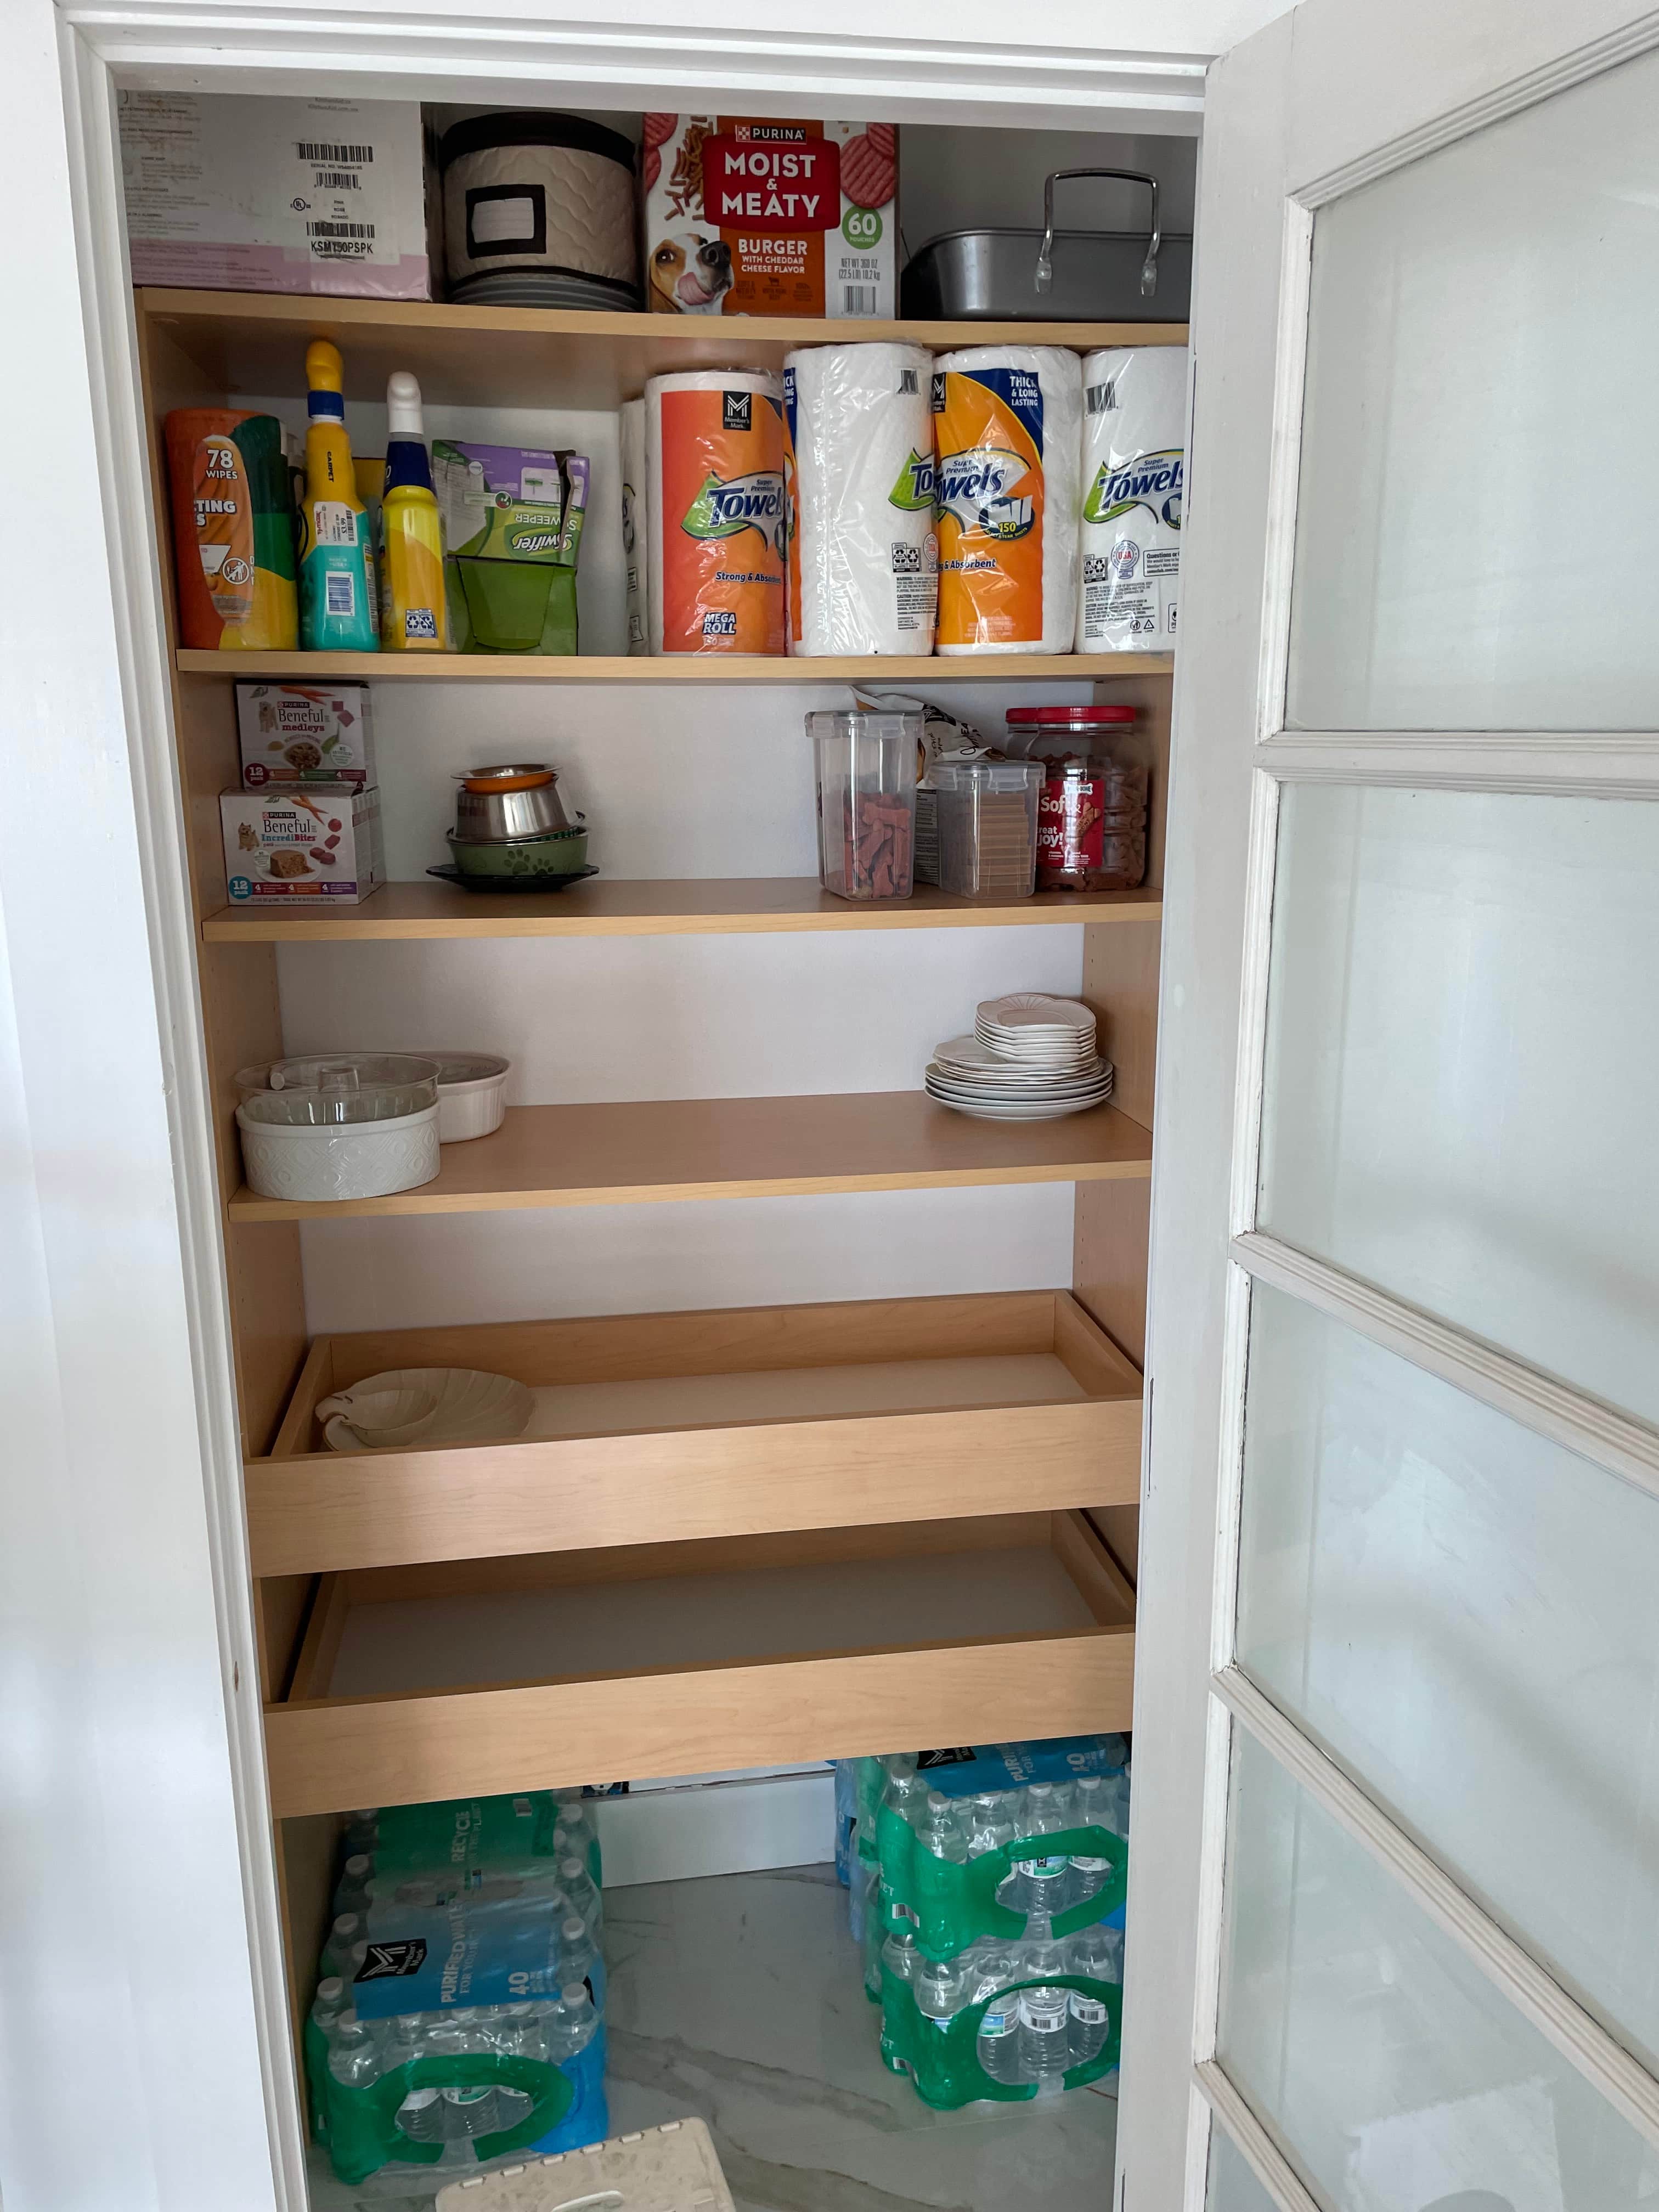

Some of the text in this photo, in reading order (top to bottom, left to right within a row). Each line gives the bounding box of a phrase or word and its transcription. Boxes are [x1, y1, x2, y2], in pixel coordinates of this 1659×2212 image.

[753, 127, 803, 140] PURINA
[725, 151, 816, 178] MOIST
[766, 178, 778, 190] &
[722, 191, 820, 218] MEATY
[848, 212, 877, 236] 60
[738, 238, 808, 255] BURGER
[742, 255, 804, 264] WITH CHEDDAR
[841, 258, 850, 268] NET
[851, 258, 860, 268] WT
[741, 264, 805, 274] CHEESE FLAVOR
[1012, 389, 1038, 398] & LONG
[1011, 398, 1038, 407] LASTING
[207, 449, 234, 469] 78
[1144, 458, 1164, 466] Super
[1137, 463, 1169, 473] Premium
[206, 470, 238, 479] WIPES
[194, 499, 236, 514] TING
[998, 522, 1017, 533] 150
[1118, 550, 1132, 560] USA
[944, 561, 949, 569] &
[950, 558, 996, 569] Absorbent
[715, 571, 746, 583] Strong
[747, 573, 752, 581] &
[704, 613, 736, 623] MEGA
[702, 622, 736, 634] ROLL
[278, 708, 324, 723] Beneful
[282, 723, 325, 733] medleys
[249, 767, 264, 776] 12
[1040, 794, 1066, 814] Sof
[263, 819, 311, 833] Beneful
[233, 880, 249, 890] 12
[460, 1972, 472, 1994] FOR
[508, 1972, 530, 1995] 40
